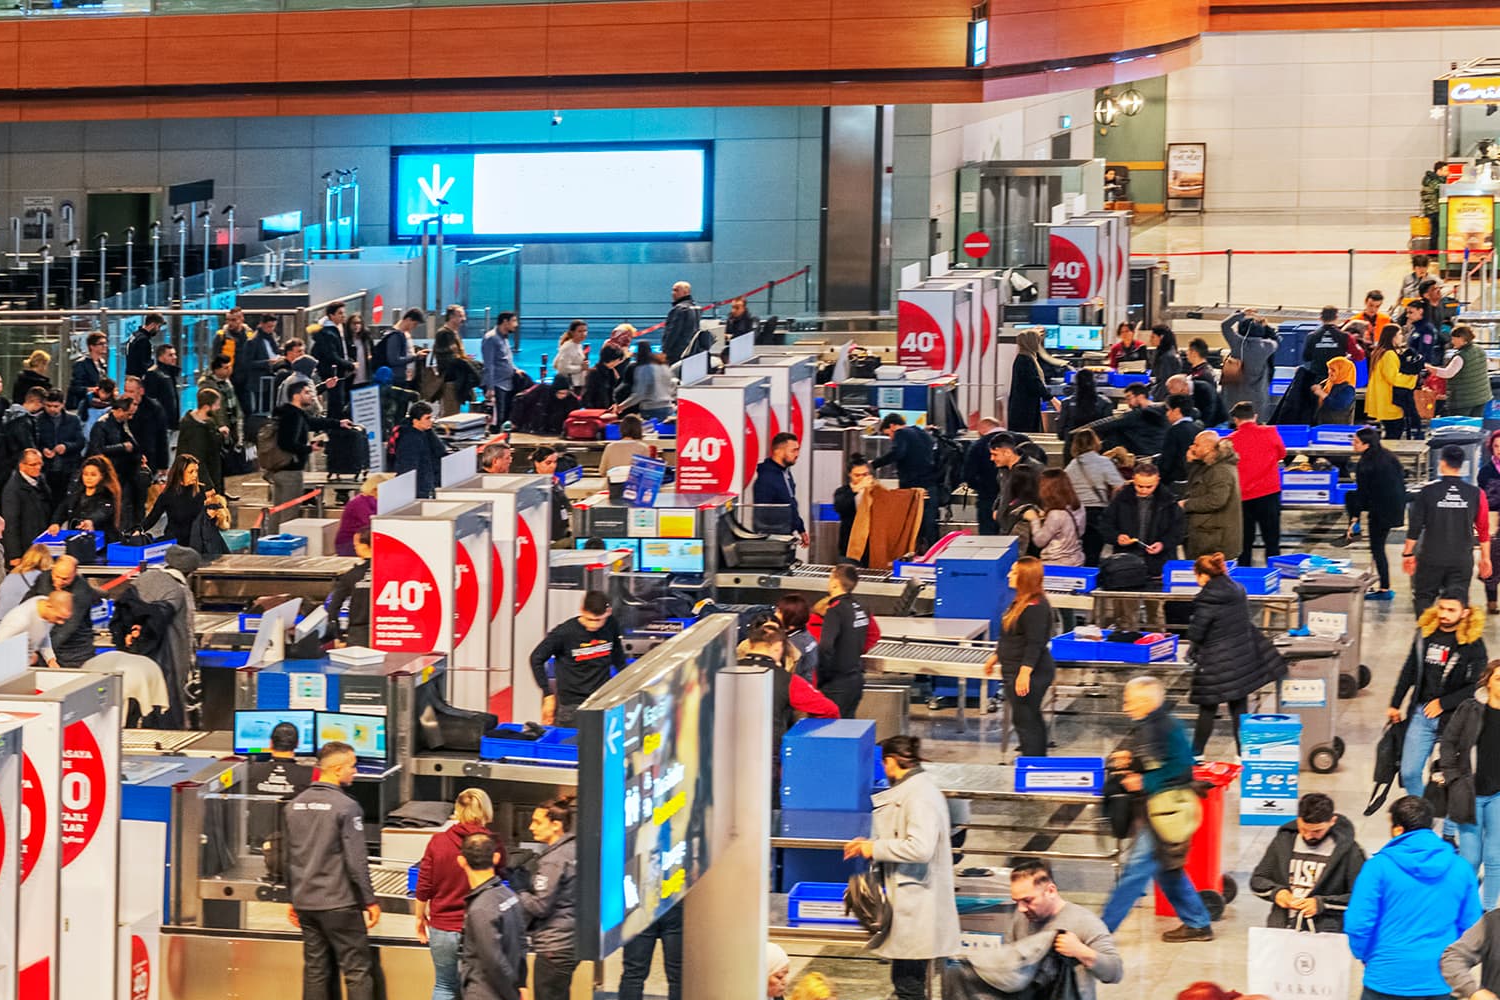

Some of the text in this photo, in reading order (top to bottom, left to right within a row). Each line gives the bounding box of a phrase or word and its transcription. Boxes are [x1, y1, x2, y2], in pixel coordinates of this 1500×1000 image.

[900, 332, 940, 352] 40%
[680, 437, 728, 462] 40%
[376, 580, 433, 611] 40%
